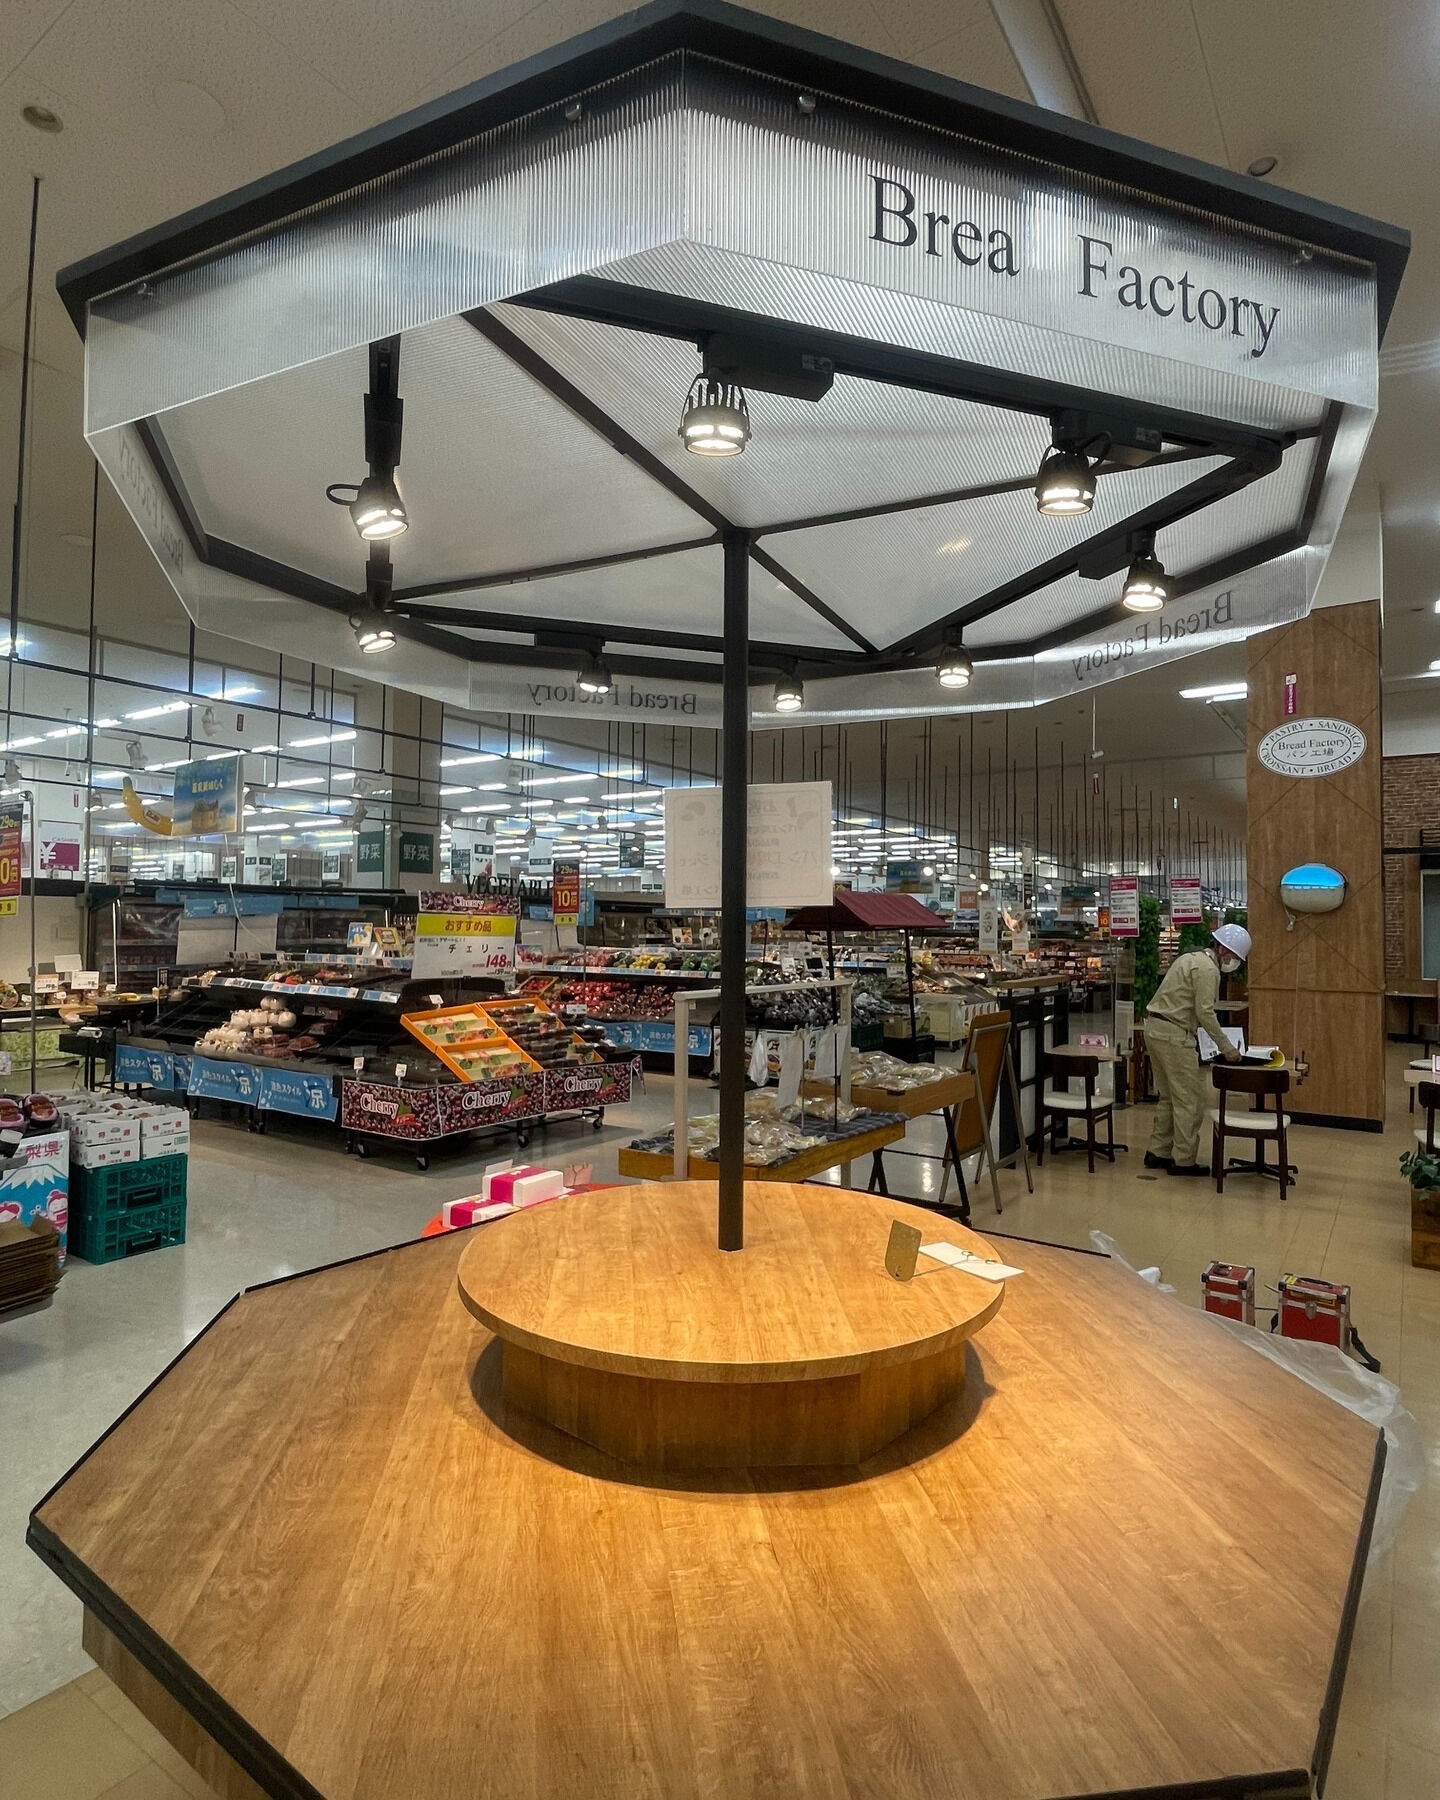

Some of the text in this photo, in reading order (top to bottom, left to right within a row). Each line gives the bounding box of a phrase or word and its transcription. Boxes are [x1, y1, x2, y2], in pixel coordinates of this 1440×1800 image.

[1076, 234, 1281, 358] Factory
[1268, 721, 1362, 748] PASTRY SANDWICH
[1278, 738, 1346, 750] Bread Factory
[1261, 748, 1352, 774] CROISSANT BREAD
[360, 843, 381, 860] 野菜
[403, 844, 430, 861] 野菜
[454, 896, 485, 909] Cherry
[445, 920, 492, 932] おすすめ品
[448, 944, 504, 954] チェリー
[564, 1076, 603, 1092] Cherry
[359, 1093, 399, 1119] Cherry
[462, 1087, 511, 1111] Cherry
